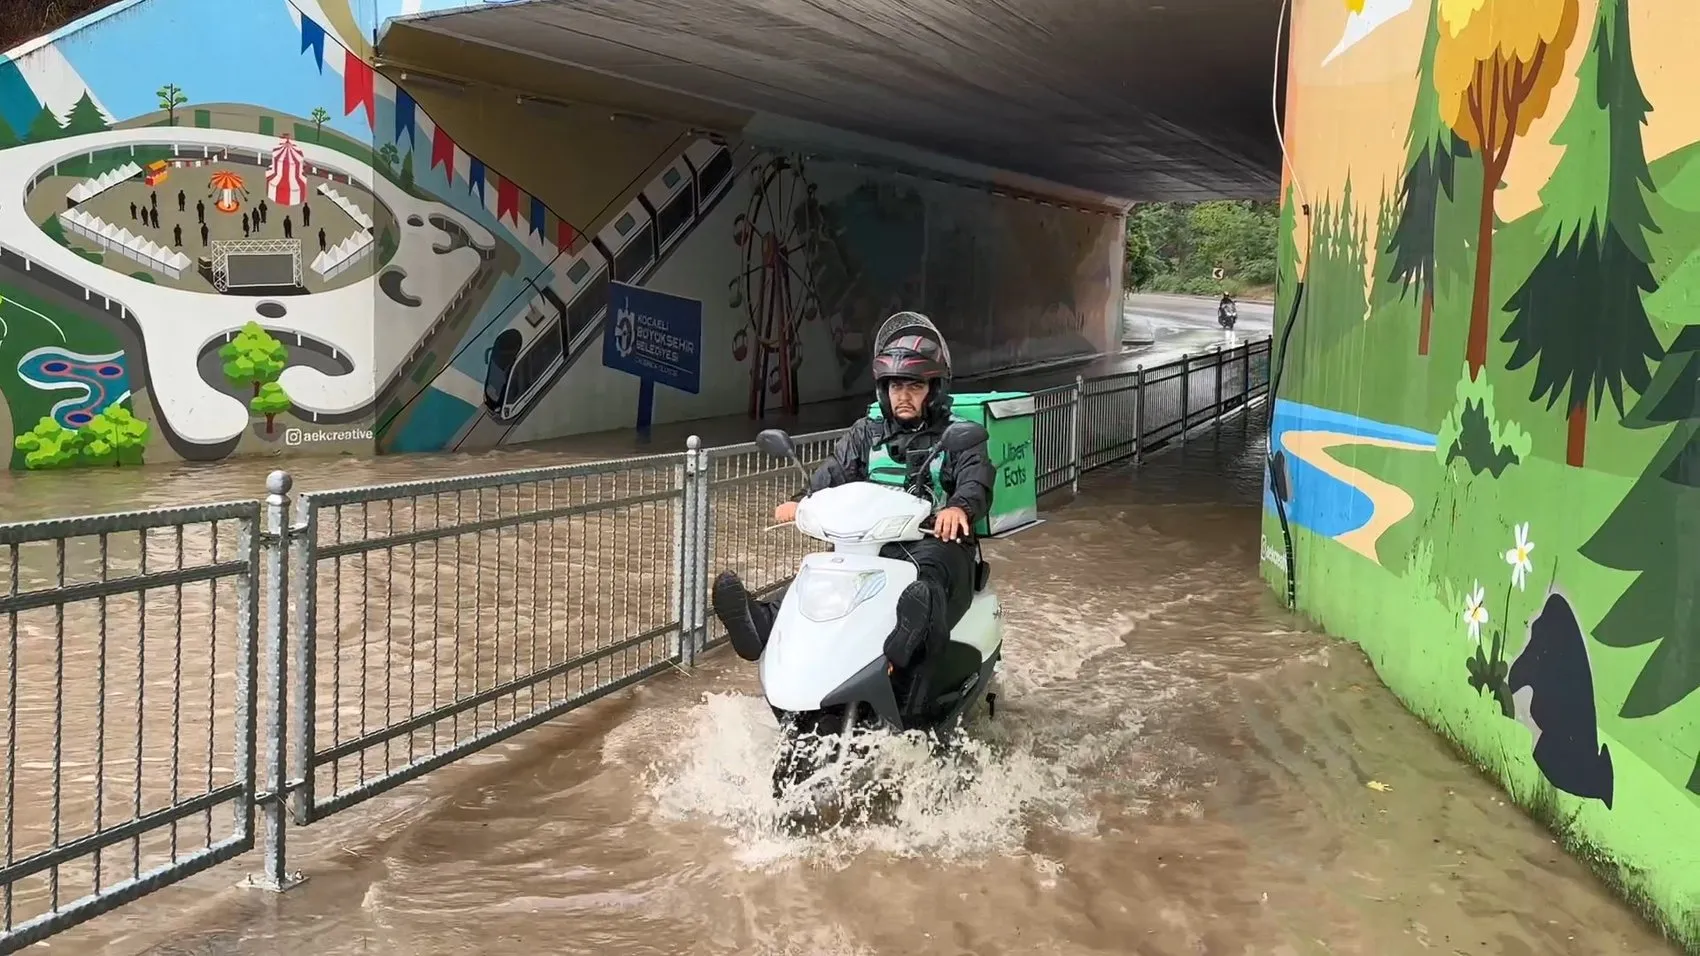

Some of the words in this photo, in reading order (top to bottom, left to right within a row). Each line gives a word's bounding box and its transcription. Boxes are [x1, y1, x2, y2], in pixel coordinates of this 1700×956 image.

[303, 428, 374, 442] aekcreative
[1002, 442, 1026, 461] Uber
[1003, 465, 1027, 487] Eats
